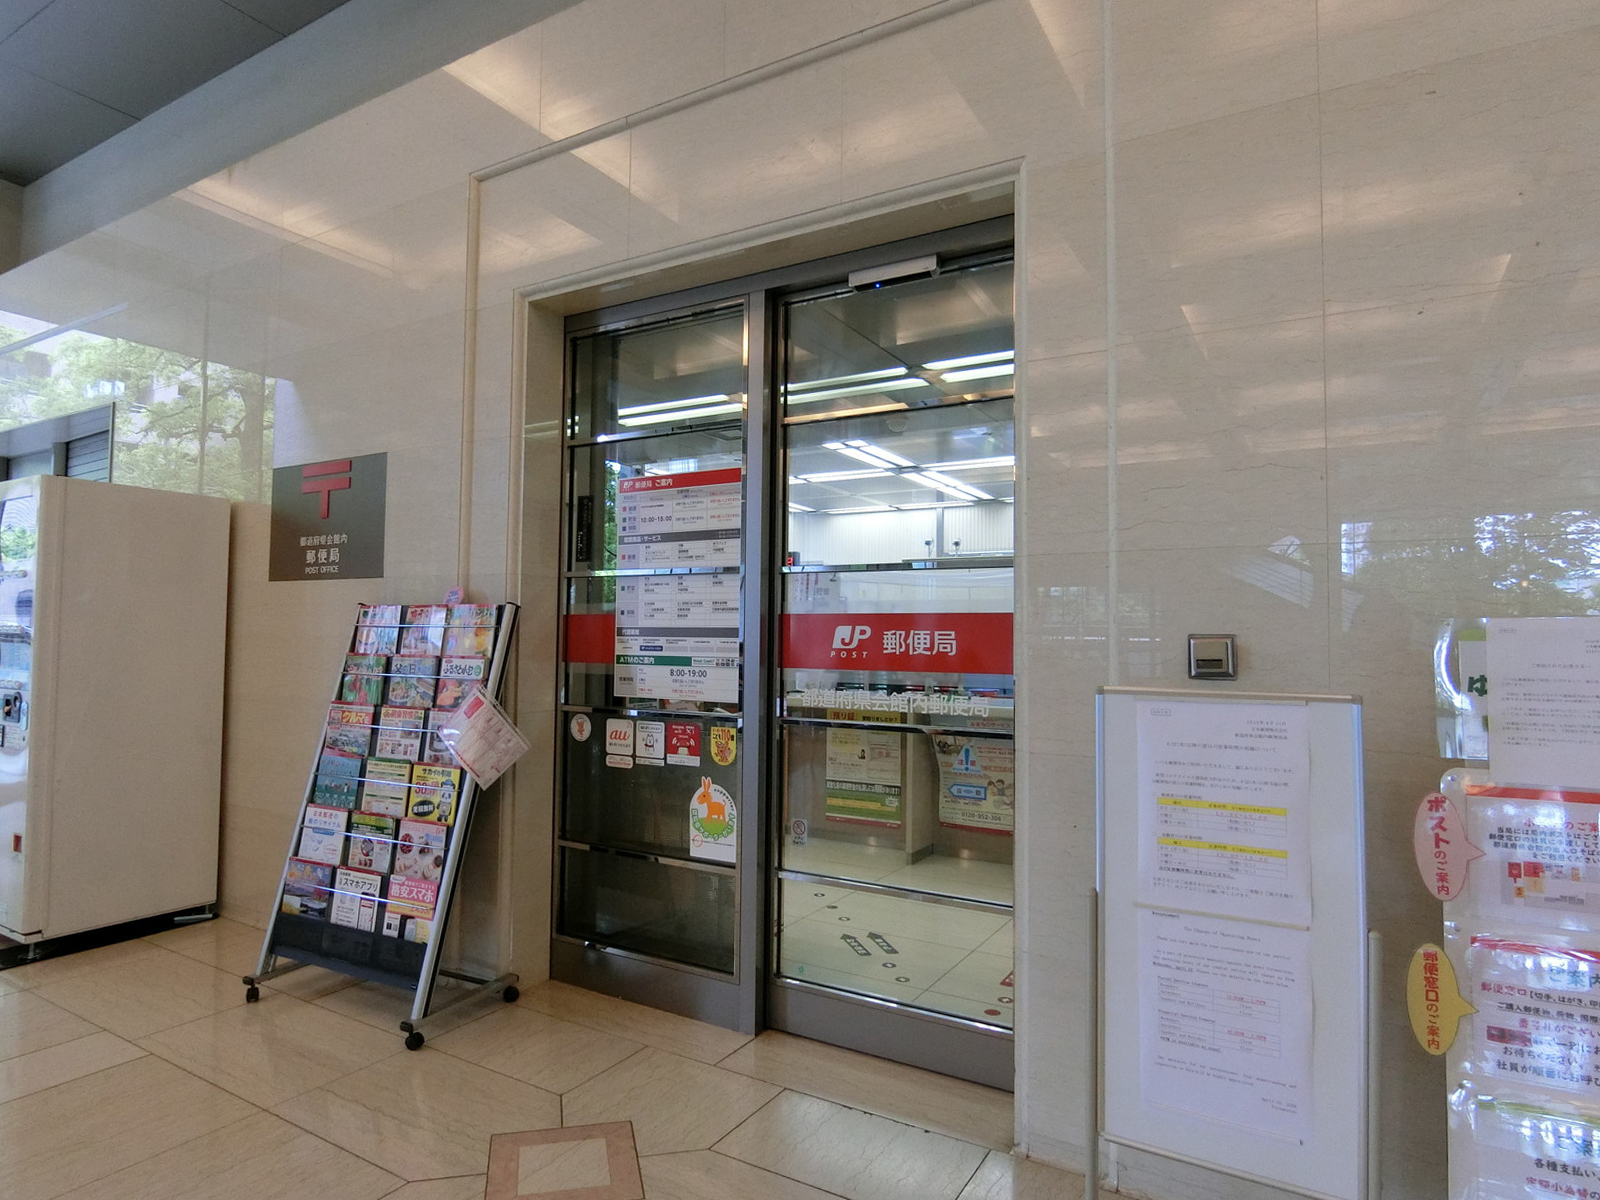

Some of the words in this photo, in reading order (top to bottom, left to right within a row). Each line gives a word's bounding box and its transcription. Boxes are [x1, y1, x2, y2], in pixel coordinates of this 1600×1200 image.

[635, 480, 652, 488] 郵便局
[655, 478, 673, 487] ご案内
[306, 548, 340, 564] 郵便局
[305, 566, 319, 574] POST
[321, 565, 339, 573] OFFICE
[832, 625, 872, 649] JP
[882, 630, 957, 656] 郵便局
[670, 669, 707, 678] 8:00-19:00
[801, 689, 990, 717] 都道府県会館内郵便局
[610, 730, 630, 741] au
[1427, 796, 1450, 895] ポストのご案内
[343, 878, 378, 892] スマホアプリ
[391, 884, 434, 902] 格安スマホ
[1423, 951, 1440, 1050] 郵便窓口のご案内
